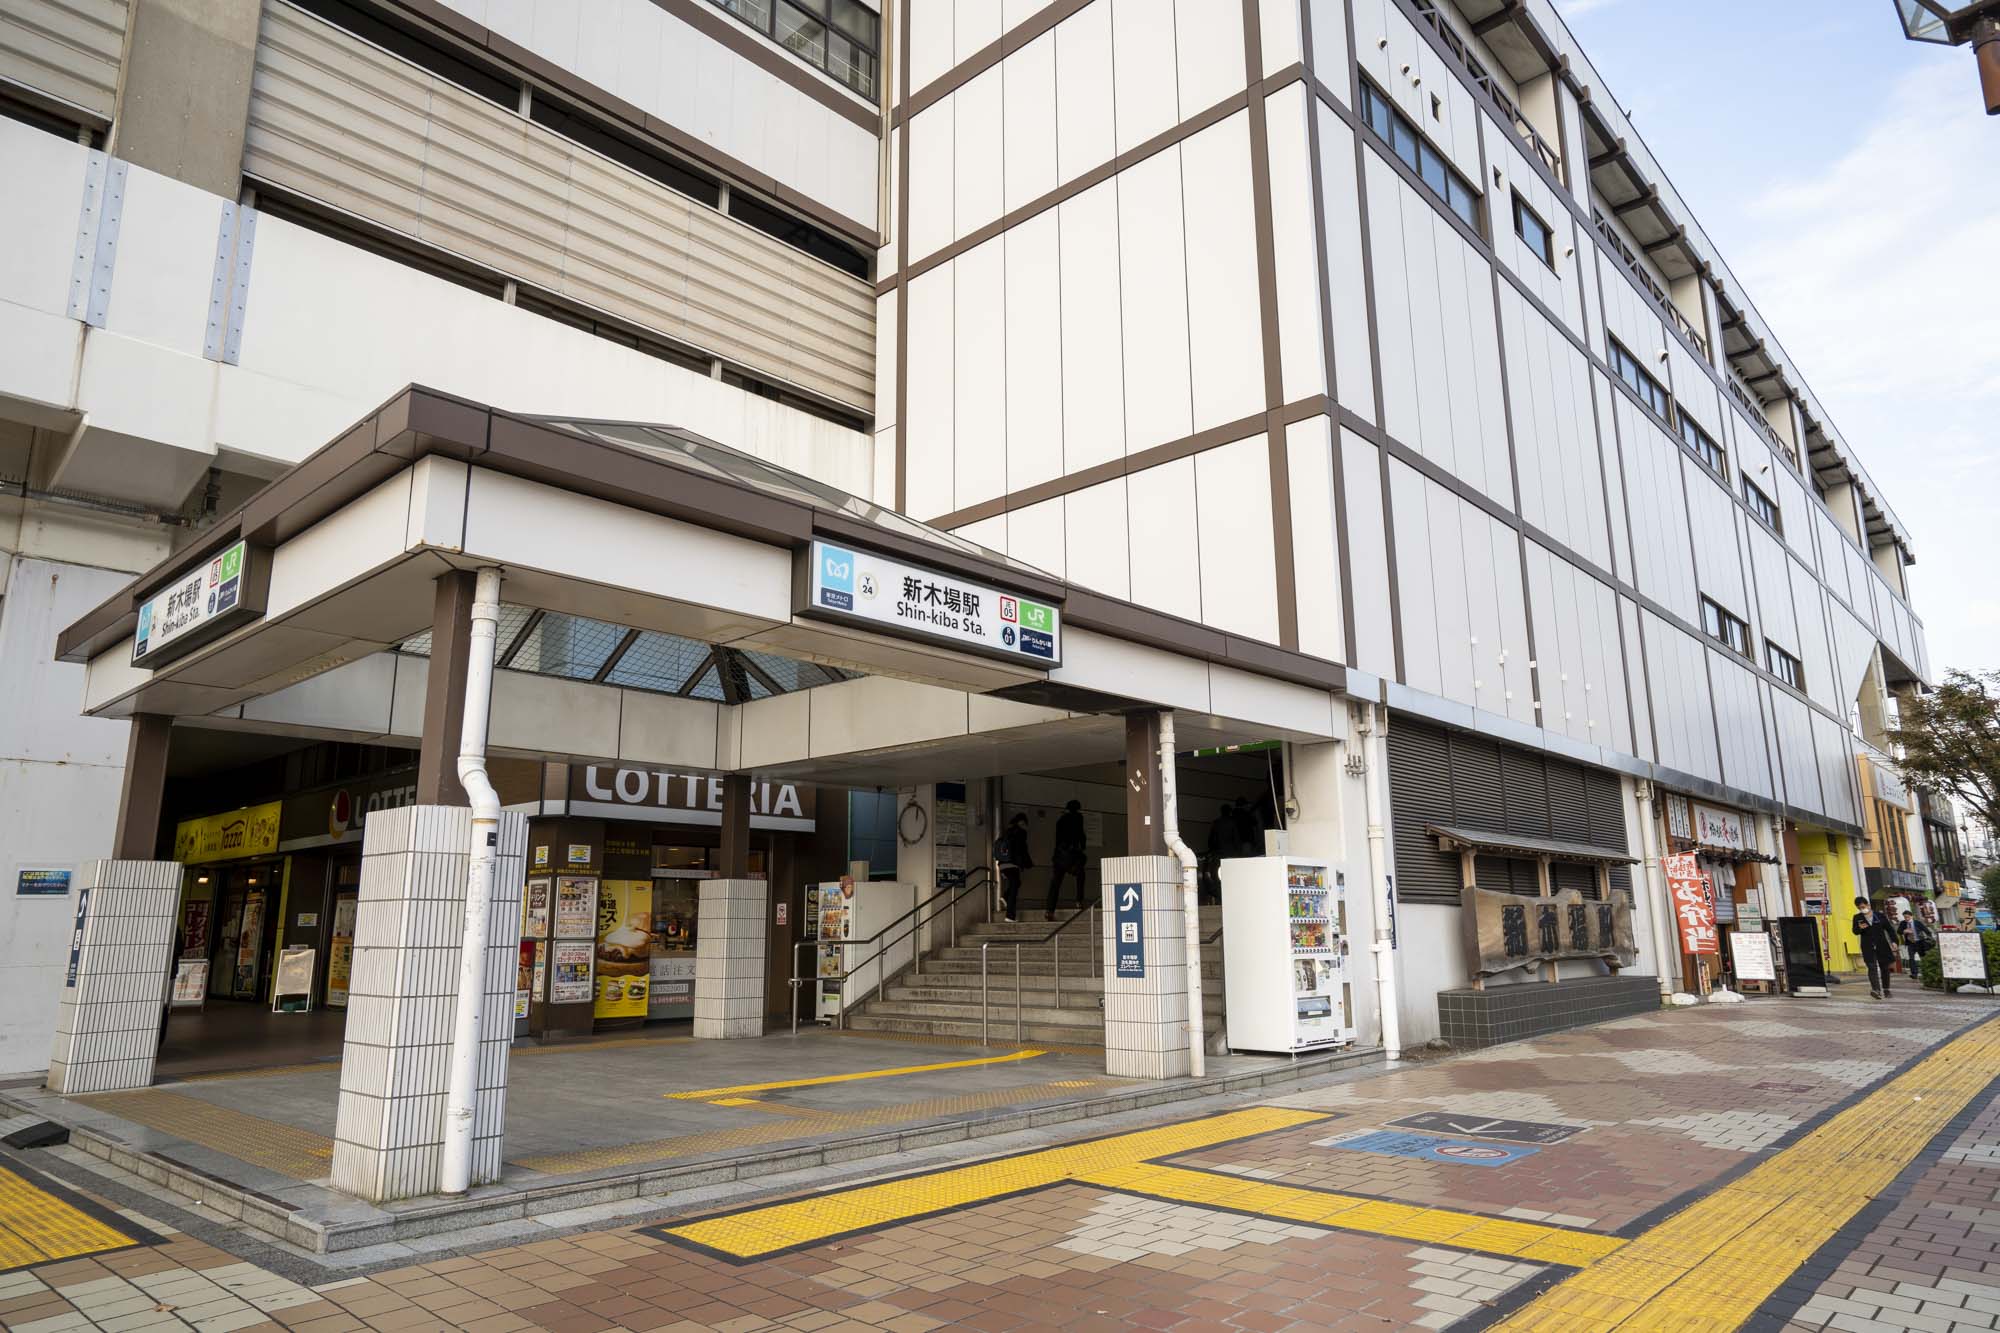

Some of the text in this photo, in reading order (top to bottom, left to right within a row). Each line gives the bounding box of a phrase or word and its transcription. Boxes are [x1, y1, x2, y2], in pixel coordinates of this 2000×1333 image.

[166, 577, 202, 618] 新木場駅
[862, 585, 873, 595] 24
[903, 576, 980, 618] 新木場駅
[897, 601, 986, 636] Shin-kiba Sta.
[1004, 608, 1013, 618] 05
[1028, 608, 1045, 623] JR
[1004, 635, 1013, 644] 01
